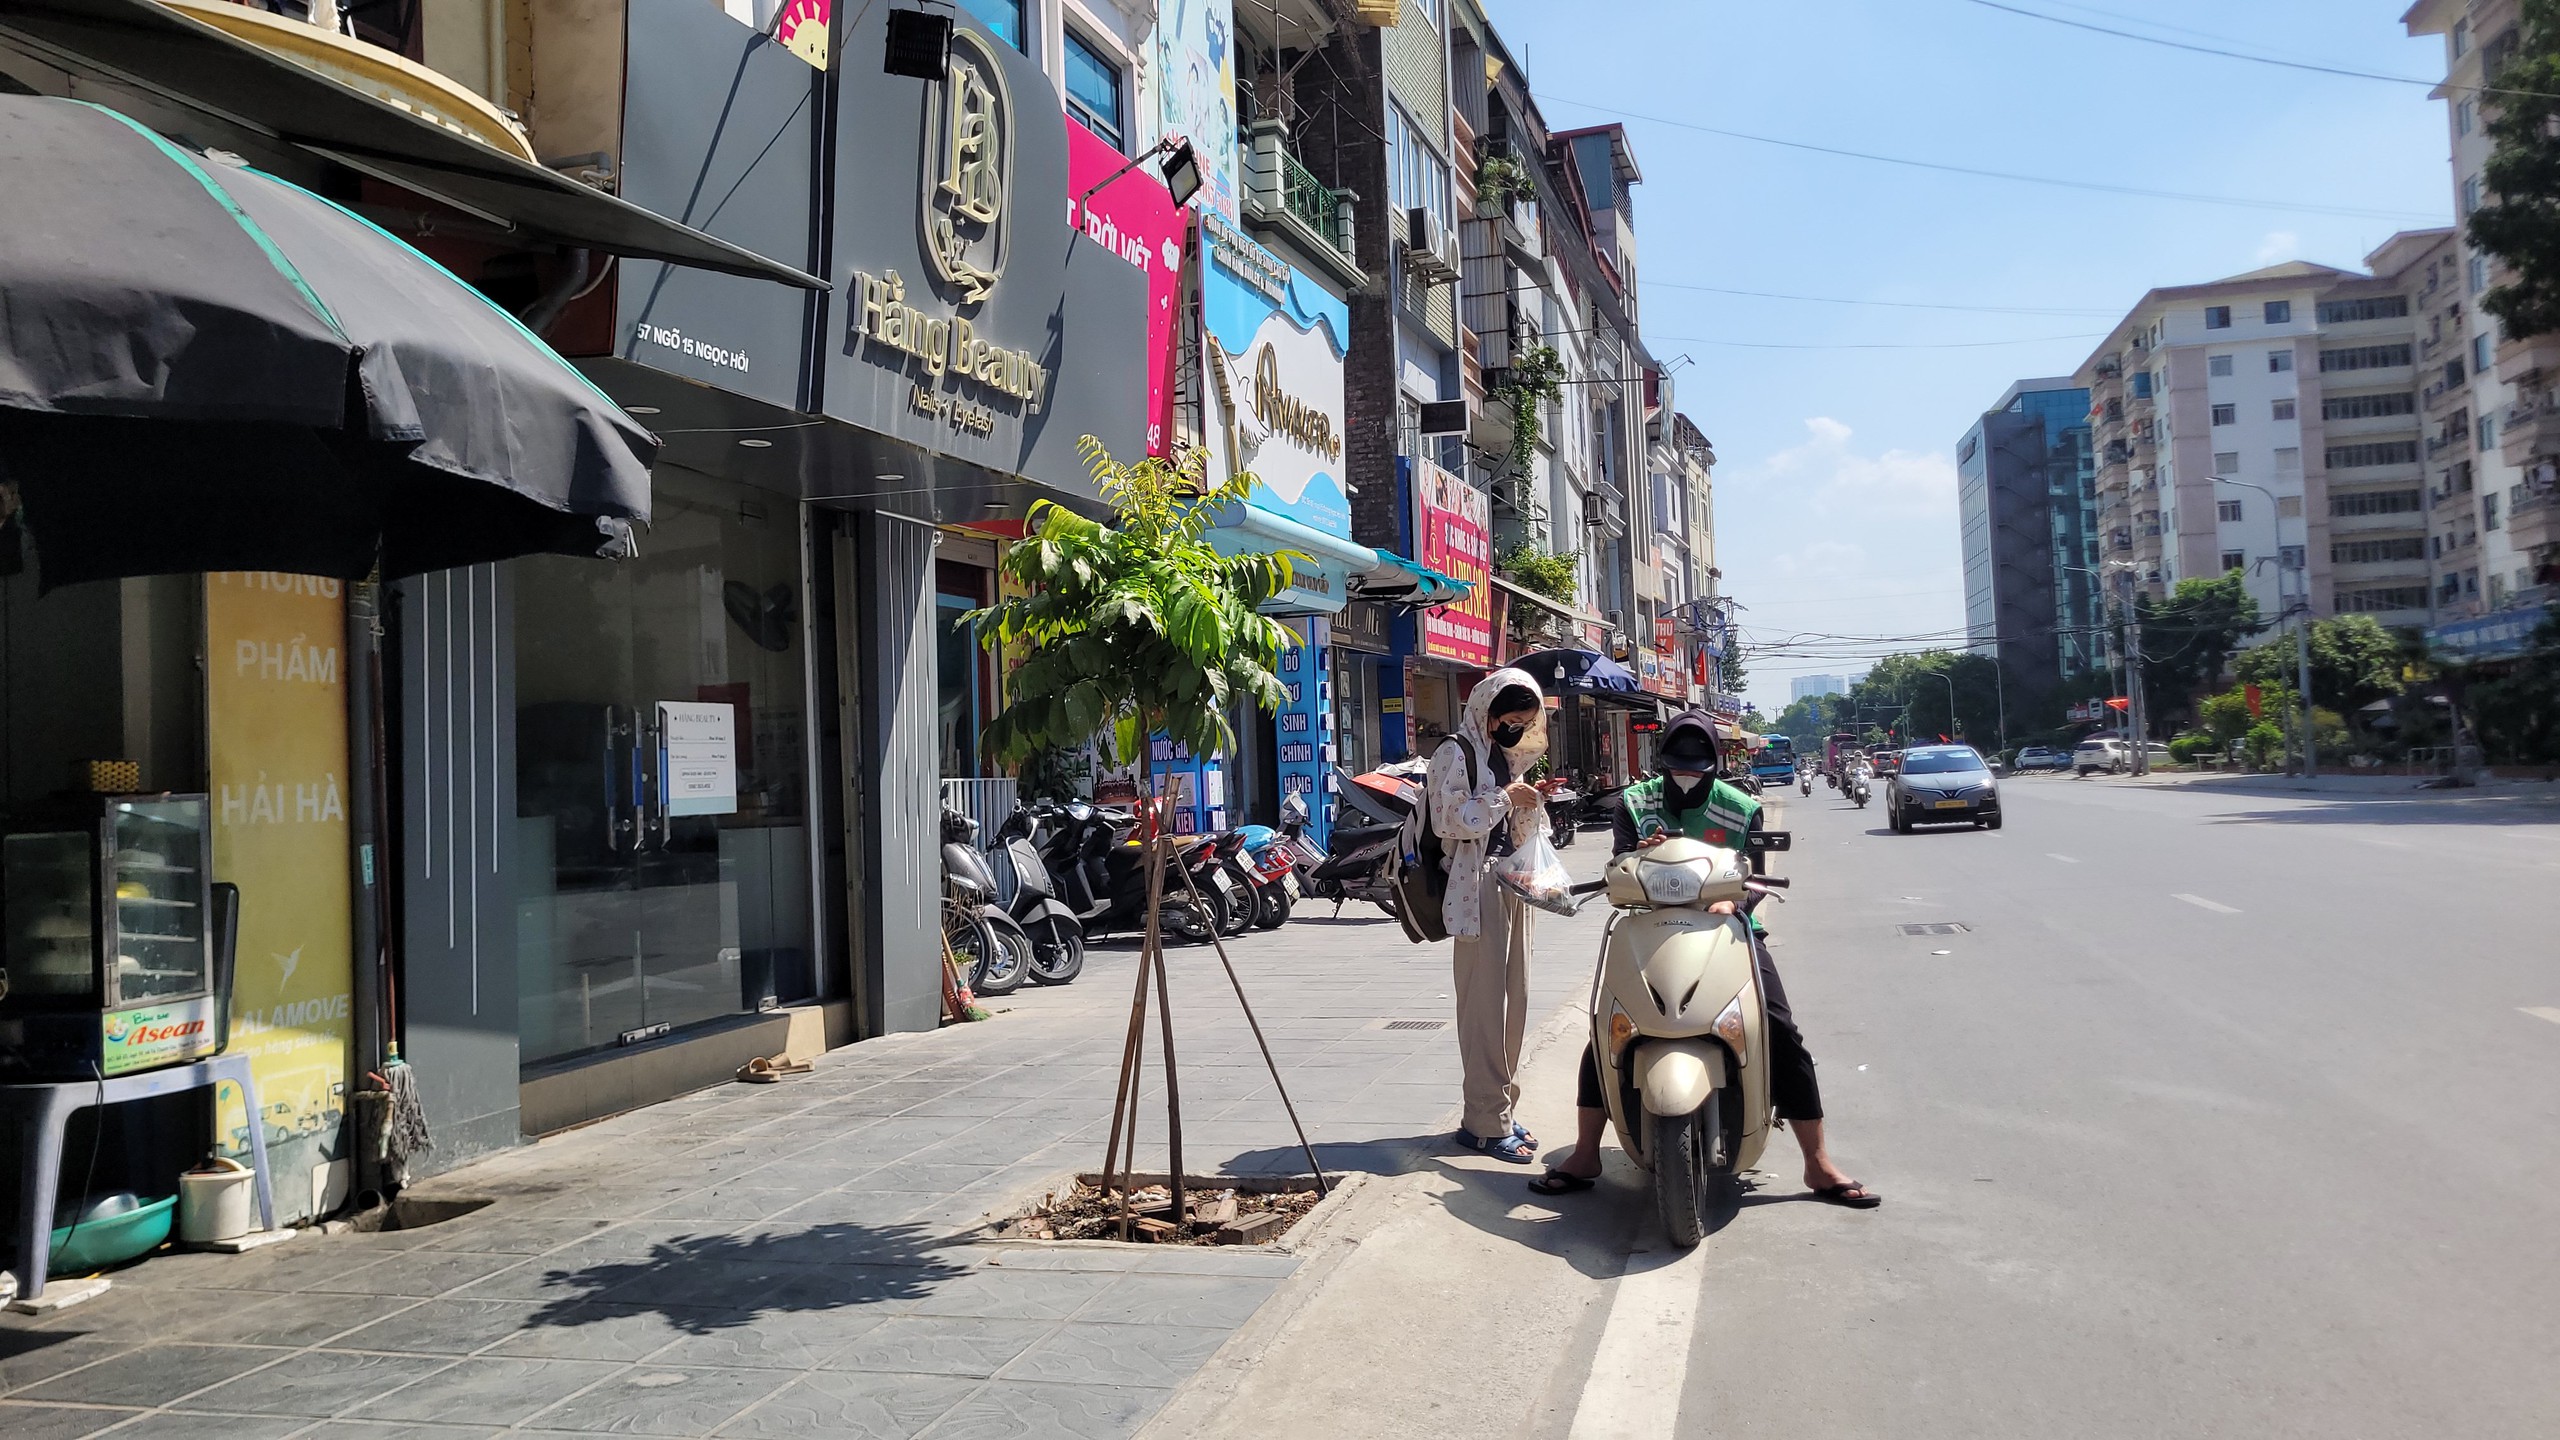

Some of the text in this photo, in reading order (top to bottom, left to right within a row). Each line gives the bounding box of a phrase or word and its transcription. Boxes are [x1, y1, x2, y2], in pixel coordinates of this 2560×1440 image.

[637, 323, 750, 373] 57 NGÕ 15 NGỌC HỒI
[949, 315, 1051, 415] Beauty
[953, 401, 996, 434] Eyelash
[1473, 565, 1491, 622] SPA
[1284, 648, 1300, 672] ĐỒ
[1282, 713, 1307, 733] SINH
[1151, 737, 1174, 762] NƯỚC
[1281, 741, 1313, 764] CHÍNH
[296, 772, 345, 823] HÀ
[126, 1018, 206, 1047] Asean
